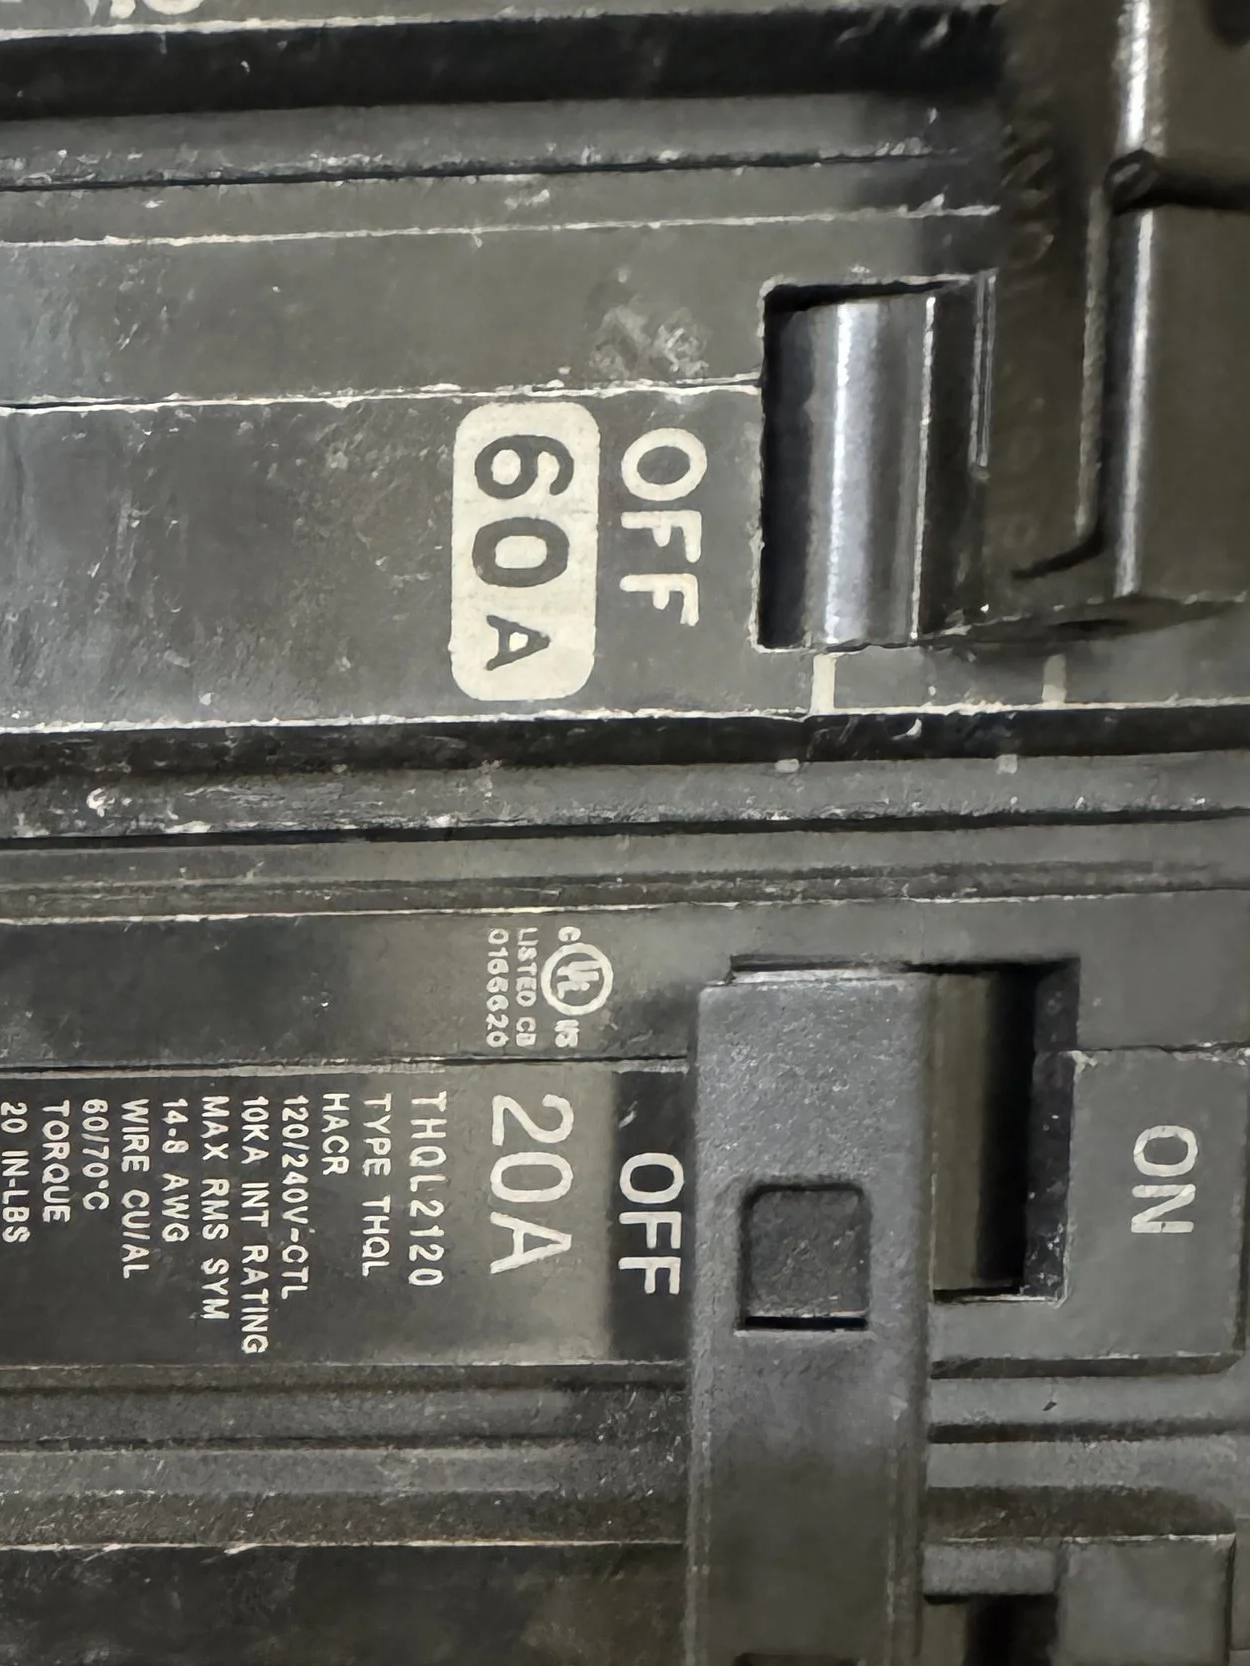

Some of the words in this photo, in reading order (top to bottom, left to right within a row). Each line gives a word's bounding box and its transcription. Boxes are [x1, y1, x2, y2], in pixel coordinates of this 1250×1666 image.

[472, 434, 574, 671] 60A
[620, 428, 707, 627] OFF
[516, 927, 539, 1007] LISTED
[515, 1017, 537, 1047] CB
[0, 1101, 29, 1134] 20
[121, 1099, 150, 1172] WIRE
[161, 1098, 189, 1154] 14-8
[200, 1096, 230, 1161] MAX
[241, 1096, 269, 1164] 10KA
[322, 1093, 349, 1176] HACR
[362, 1093, 392, 1177] TYPE
[1, 1150, 30, 1244] IN-LBS
[42, 1100, 71, 1223] TORQUE
[281, 1095, 309, 1300] 120/240V-CTL
[408, 1091, 448, 1287] THQL2120
[490, 1094, 574, 1275] 20A
[1131, 1124, 1199, 1235] ON
[121, 1189, 150, 1279] CU/AL
[161, 1173, 190, 1242] AWG
[200, 1179, 230, 1240] RMS
[241, 1182, 269, 1228] INT
[361, 1196, 392, 1277] THQL
[618, 1152, 685, 1295] OFF
[200, 1258, 230, 1319] SYM
[241, 1245, 270, 1354] RATING
